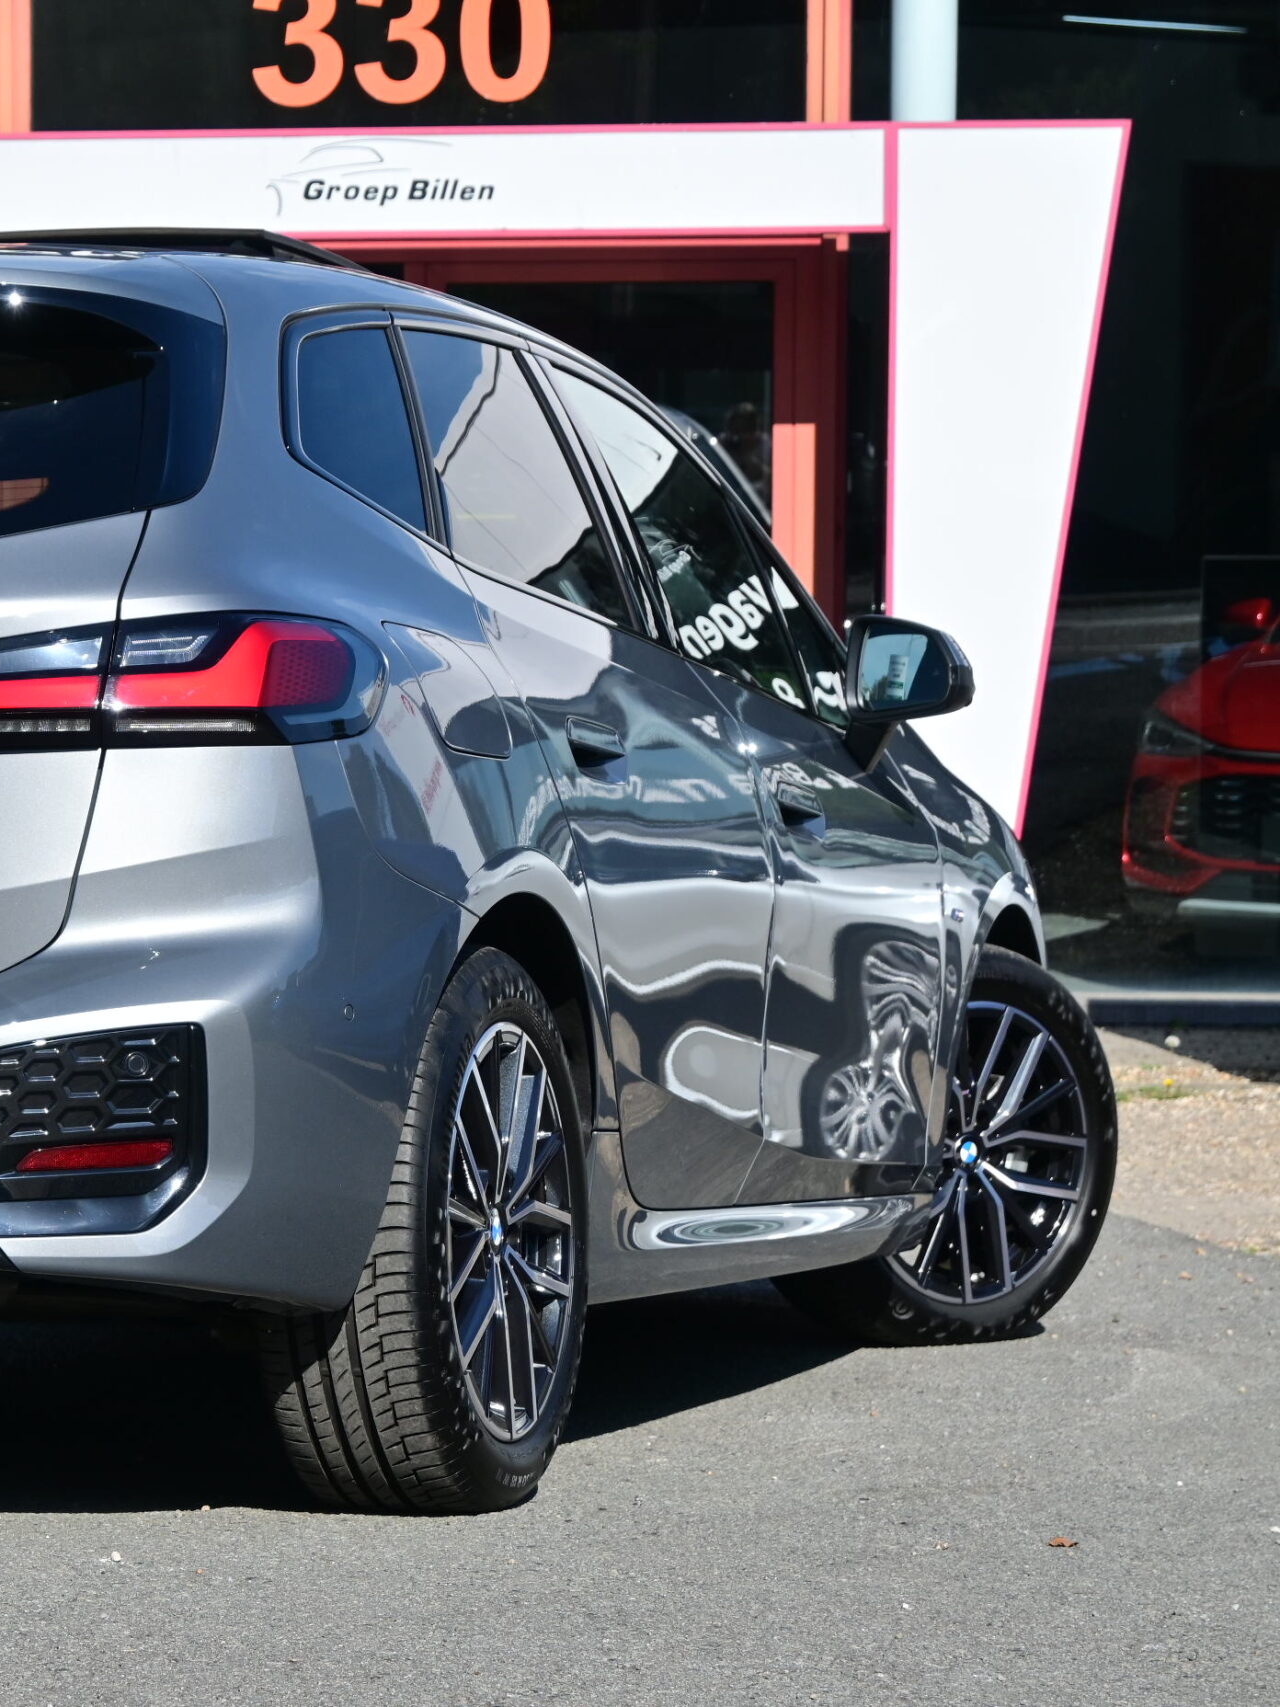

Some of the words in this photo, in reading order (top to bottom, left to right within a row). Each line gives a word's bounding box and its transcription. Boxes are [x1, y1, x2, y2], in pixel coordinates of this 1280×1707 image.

[252, 0, 552, 108] 330
[302, 179, 399, 207] Groep
[407, 178, 496, 201] Billen
